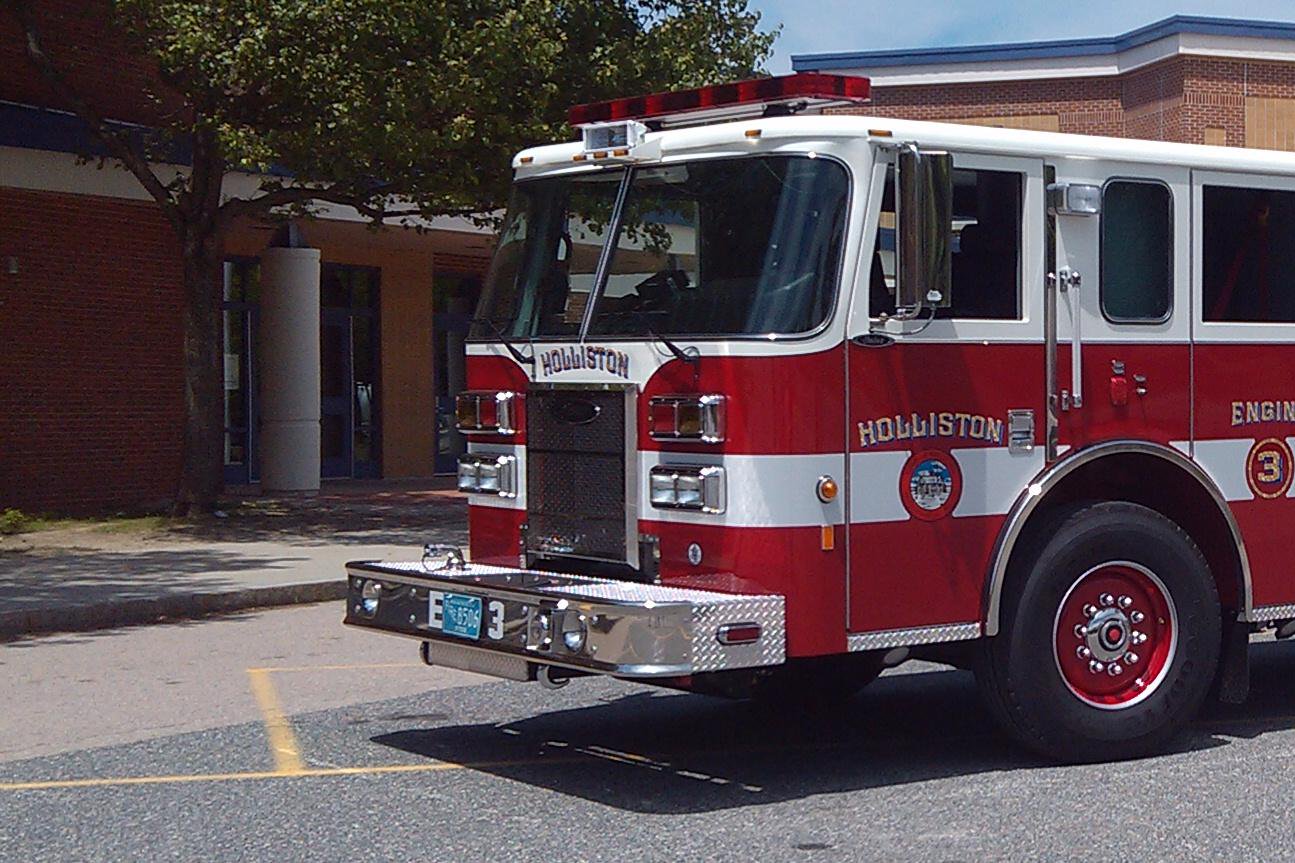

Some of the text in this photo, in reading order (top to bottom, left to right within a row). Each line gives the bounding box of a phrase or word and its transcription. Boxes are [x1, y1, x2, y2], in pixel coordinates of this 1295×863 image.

[541, 345, 629, 379] HOLLISTON
[857, 412, 1004, 447] HOLLISTON
[1257, 451, 1282, 483] 3
[429, 590, 444, 629] E
[488, 601, 504, 639] 3
